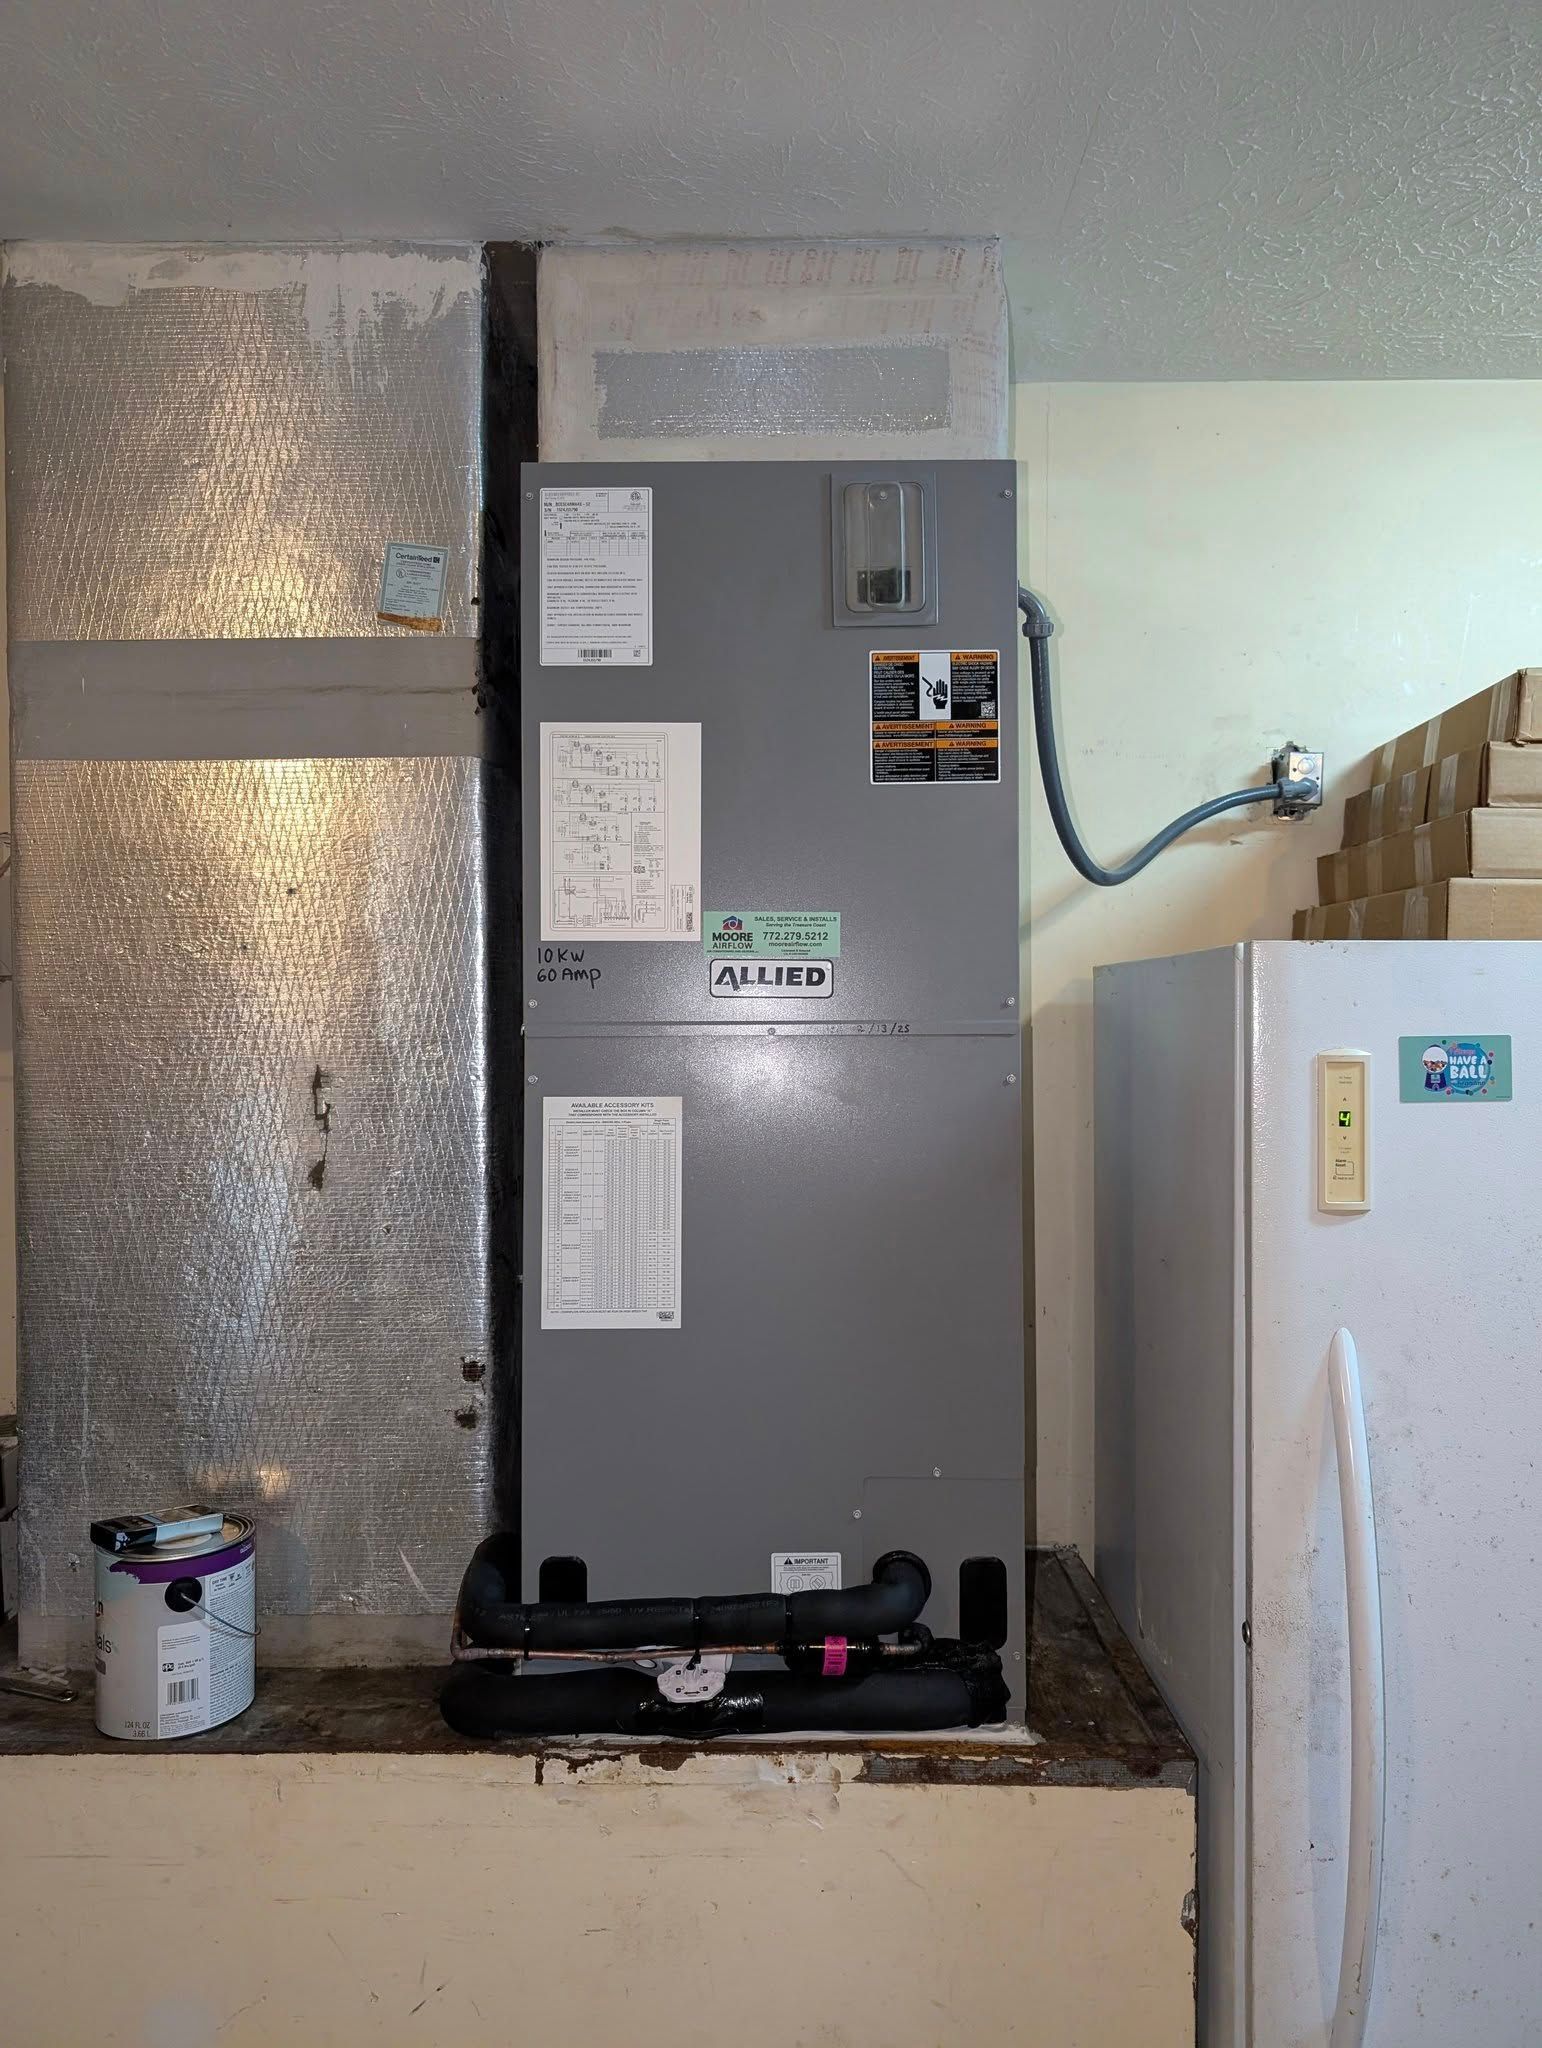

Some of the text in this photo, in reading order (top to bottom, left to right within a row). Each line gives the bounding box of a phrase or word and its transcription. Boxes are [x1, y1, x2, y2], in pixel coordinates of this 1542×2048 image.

[712, 932, 754, 942] MOORE
[763, 931, 829, 941] 772.279.5212
[712, 942, 753, 950] AIRFLOW
[537, 968, 557, 982] 60
[714, 966, 826, 991] ALLIED
[1449, 1055, 1488, 1065] HAVE A
[1450, 1065, 1488, 1079] BALL
[1339, 1112, 1350, 1126] 4
